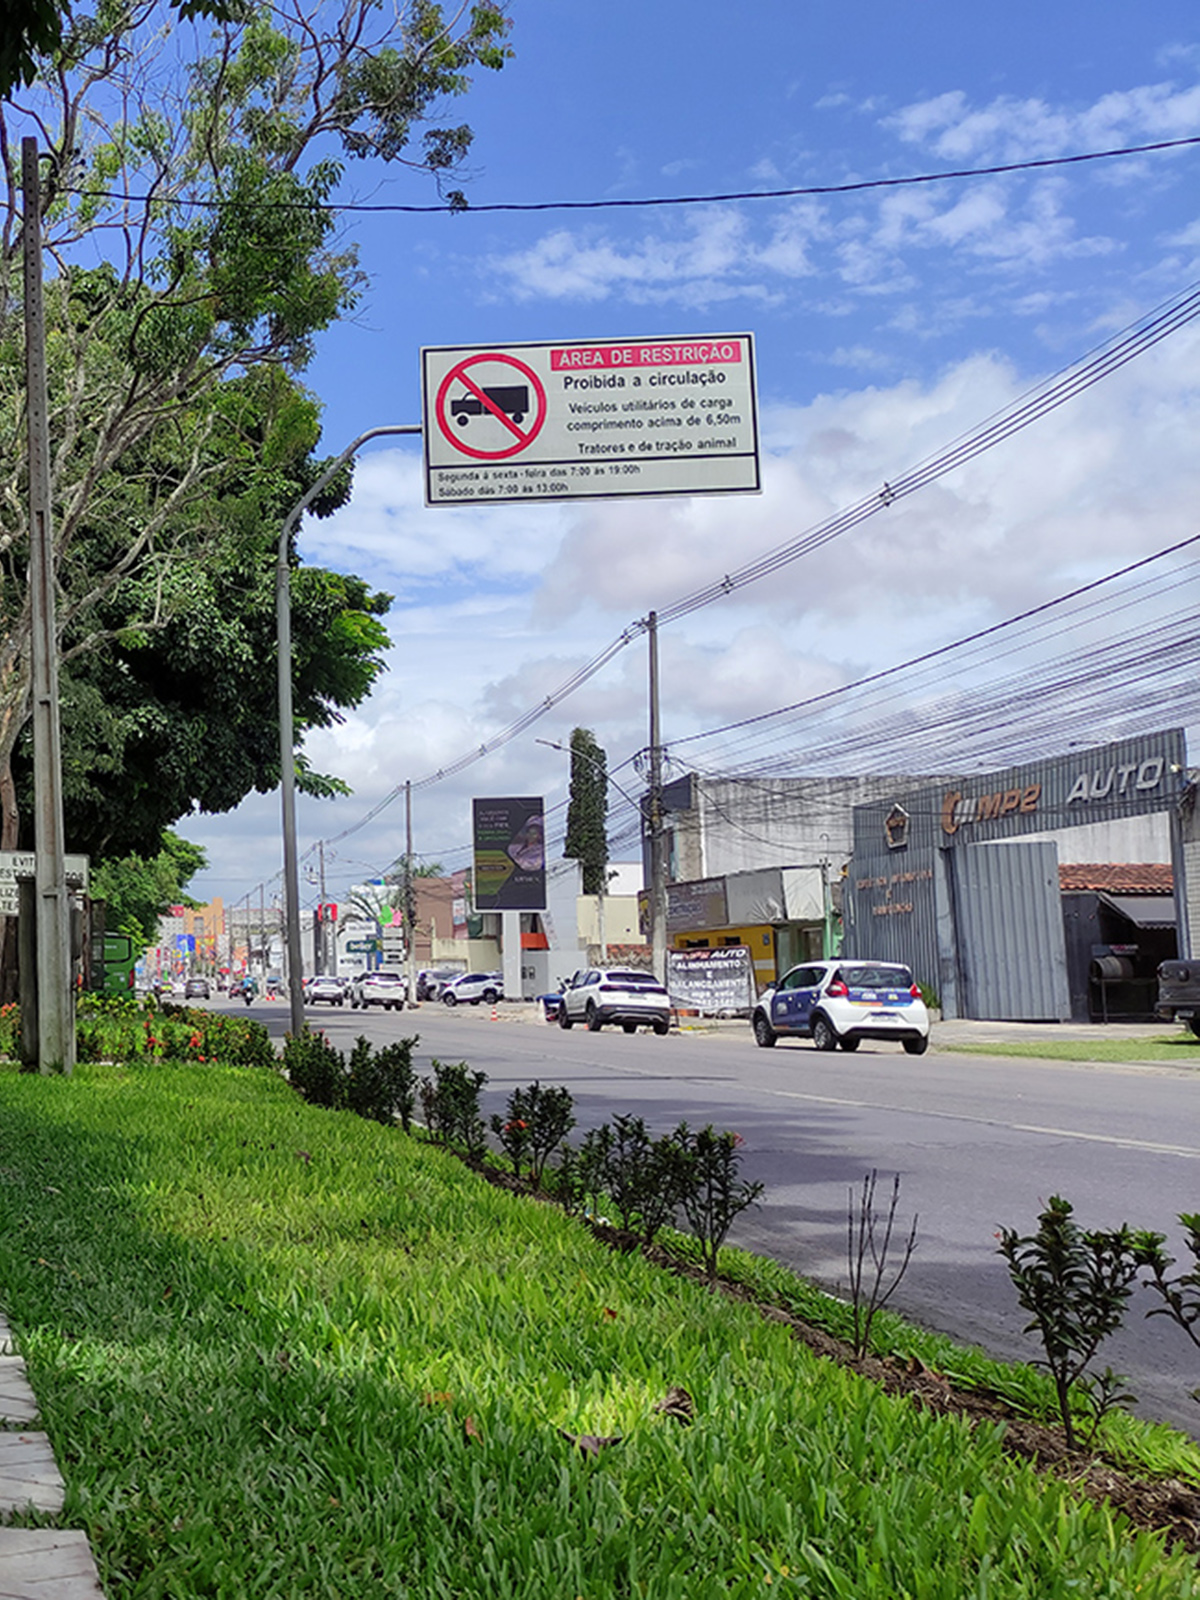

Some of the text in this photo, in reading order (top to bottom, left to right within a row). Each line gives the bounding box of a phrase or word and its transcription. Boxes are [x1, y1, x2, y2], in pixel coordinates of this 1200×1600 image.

[559, 343, 735, 367] ÁREA DE RESTRIÇÃO
[563, 369, 727, 390] Proibida a circulação
[569, 398, 733, 414] Veículos utilitários de carga
[566, 413, 741, 433] comprimento acima de 6,50m
[577, 436, 737, 455] Tratores e de tração animal
[438, 471, 480, 483] Segunda
[549, 467, 568, 478] das
[570, 466, 591, 477] 7:00
[608, 464, 642, 475] 19:00h
[498, 484, 520, 495] 7:00
[1065, 757, 1166, 805] AUTO
[12, 857, 36, 868] EVIT
[710, 949, 747, 959] AUTO
[676, 959, 741, 970] ALINHAMENTO
[705, 970, 714, 979] E
